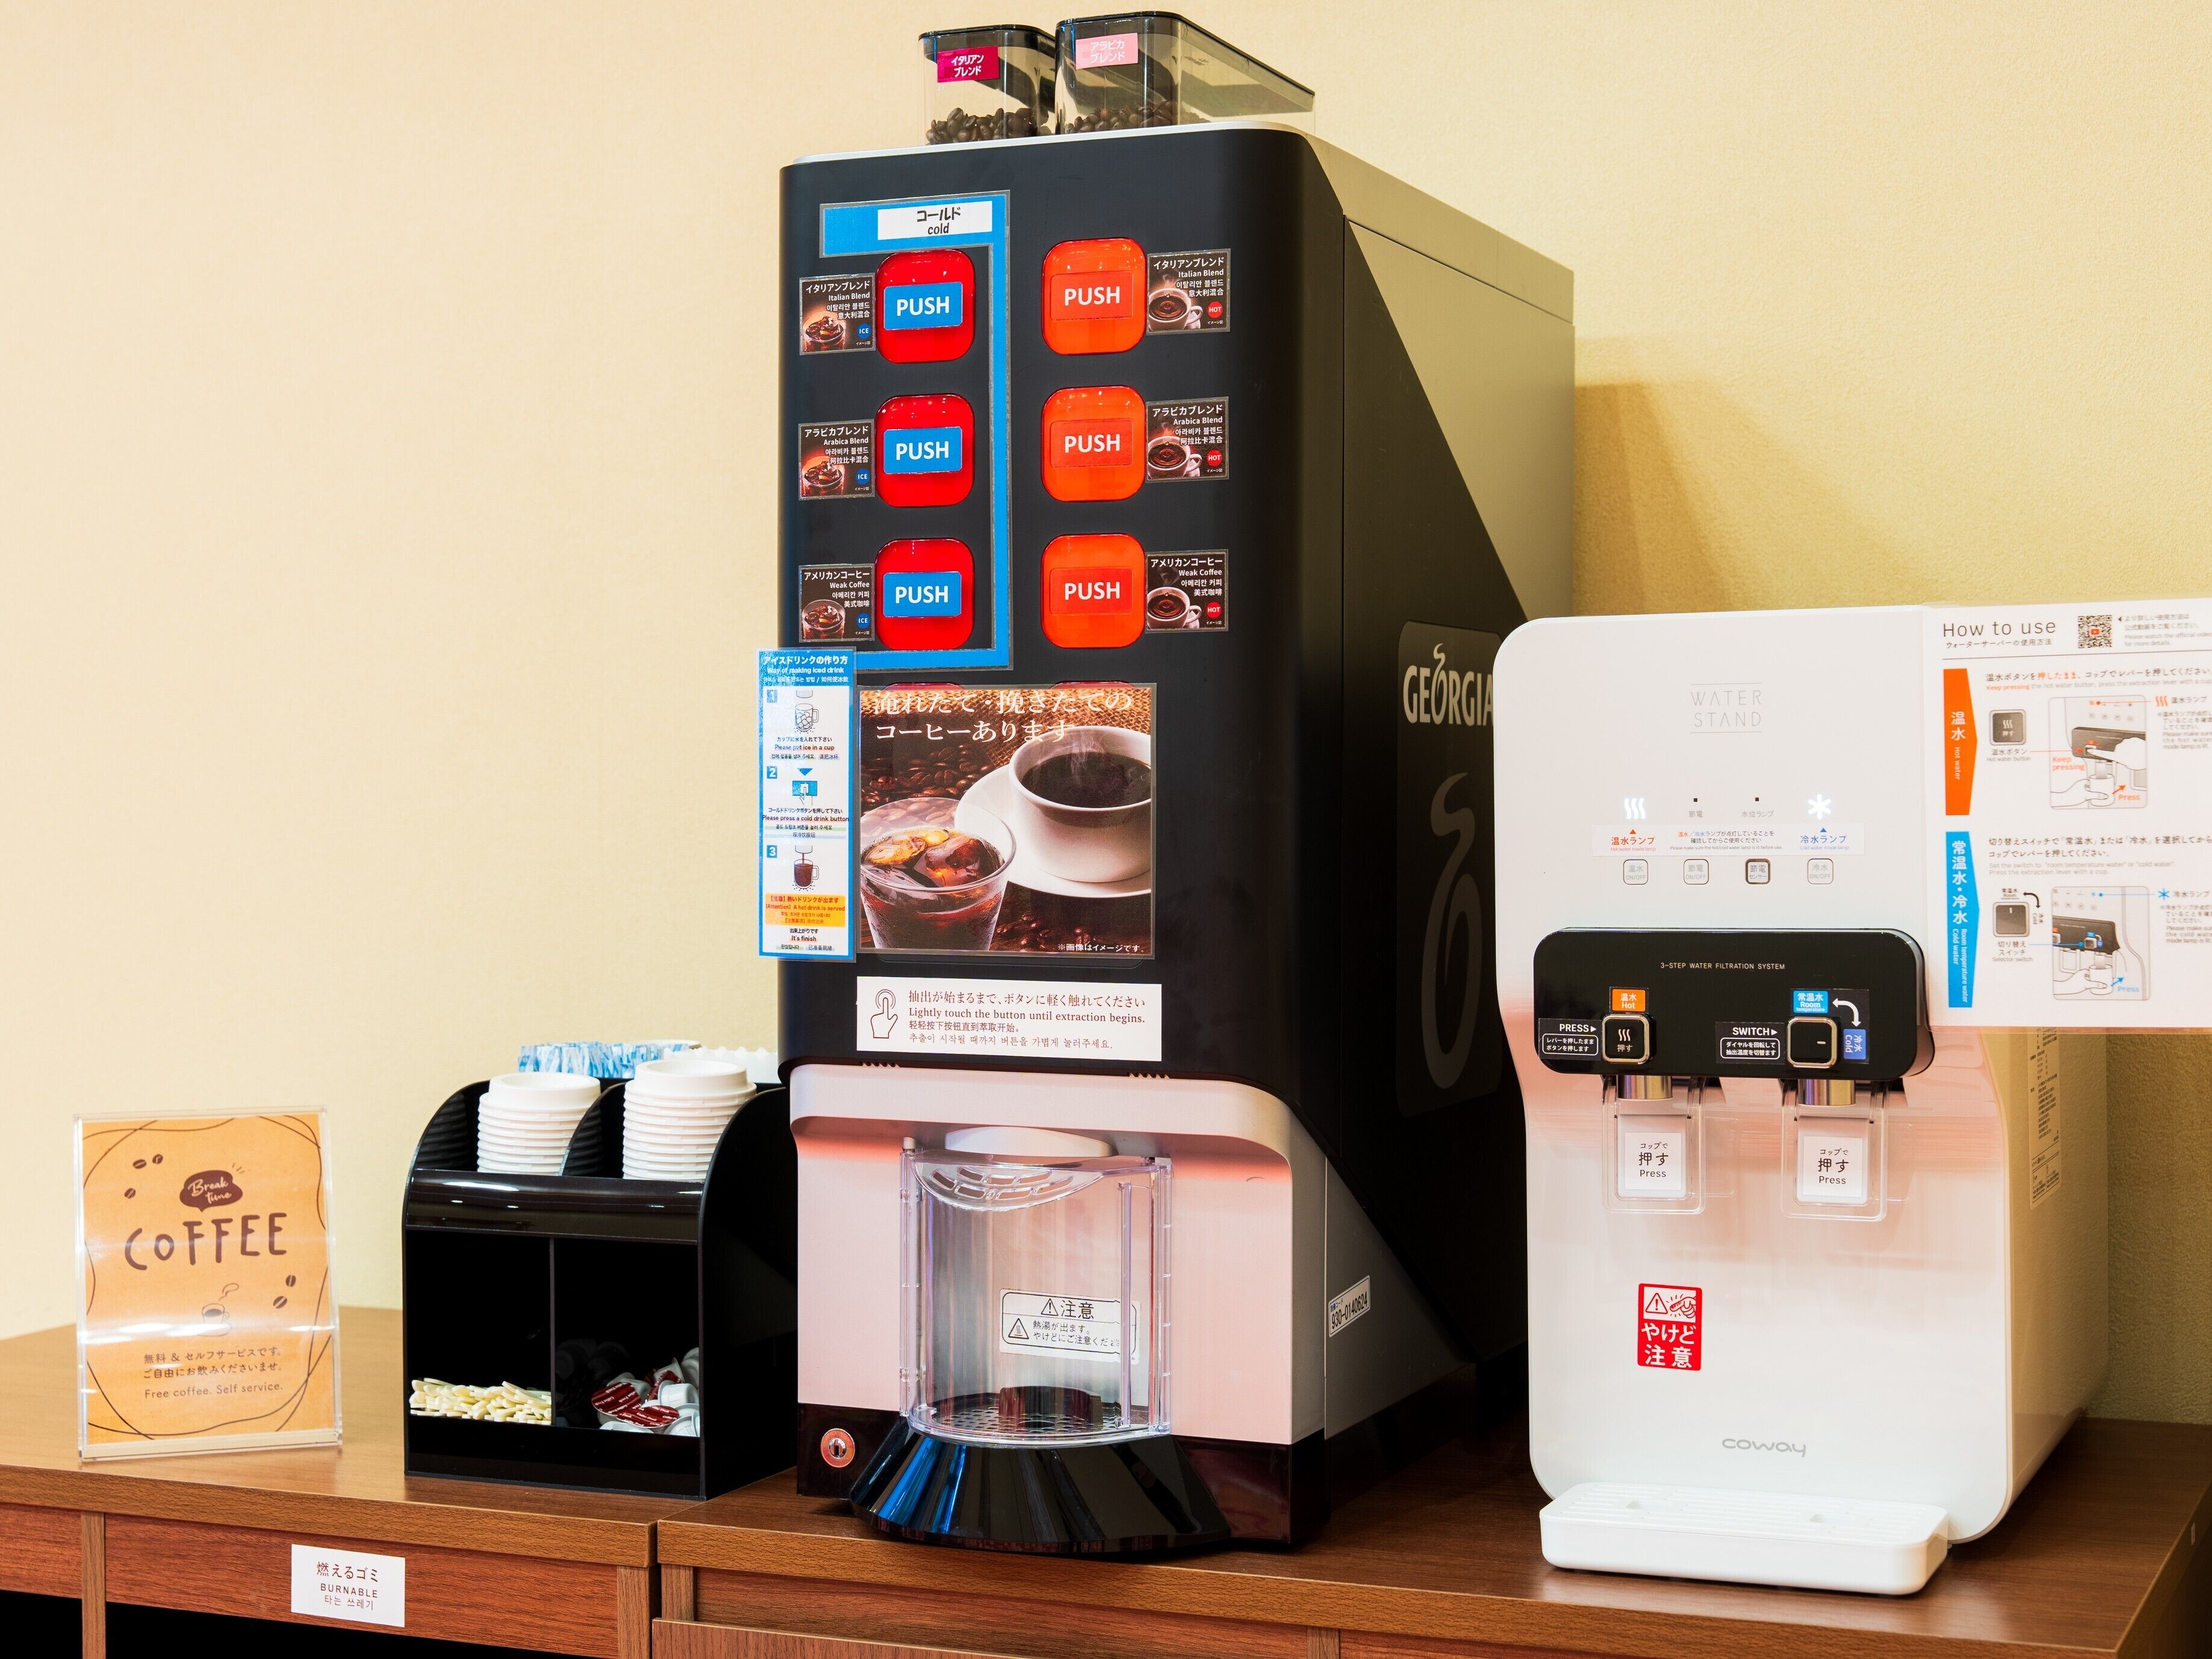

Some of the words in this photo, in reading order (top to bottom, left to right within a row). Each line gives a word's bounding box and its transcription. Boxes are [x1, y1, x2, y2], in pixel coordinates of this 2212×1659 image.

[1091, 40, 1125, 53] アラビカ
[951, 54, 984, 67] イタリアン
[1090, 51, 1126, 63] ブレンド
[953, 64, 982, 77] ブレンド
[916, 207, 961, 222] コールド
[928, 222, 949, 235] cold
[1153, 257, 1224, 270] イタリアンブレンド
[806, 281, 870, 294] イタリアンブレンド
[1188, 288, 1223, 297] 意大利混合
[1065, 286, 1120, 306] PUSH
[897, 296, 949, 316] PUSH
[838, 311, 870, 320] 意大利混合
[1153, 405, 1222, 417] アラビカブレンド
[805, 426, 868, 438] アラビカブレンド
[1203, 427, 1222, 435] 블렌드
[1065, 434, 1120, 453] PUSH
[1181, 436, 1222, 445] 阿拉比卡混合
[896, 441, 949, 460] PUSH
[831, 456, 869, 465] 阿拉比卡混合
[1151, 557, 1222, 568] アメリカンコーヒー
[804, 571, 870, 581] アメリカンコーヒー
[896, 586, 949, 603] PUSH
[1065, 581, 1120, 600] PUSH
[1943, 622, 1984, 637] How
[1994, 621, 2012, 635] to
[2022, 620, 2057, 634] use
[1946, 638, 2052, 648] ウォーターサーバーの使用方法
[764, 656, 848, 665] アイスドリンクの作り方
[1403, 643, 1494, 727] GEORGIA
[1691, 690, 1762, 705] WATER
[1694, 712, 1762, 727] STAND
[1951, 712, 1966, 740] 温水
[876, 721, 1075, 743] コーヒーあります
[769, 768, 776, 777] 2
[1611, 837, 1655, 845] 温水ランプ
[1801, 835, 1847, 843] 冷水ランプ
[769, 847, 776, 856] 3
[1952, 840, 1968, 925] 常温水・冷水
[1058, 943, 1144, 953] ※画像はイメージです。
[908, 990, 1145, 1008] 抽出が始まるまで、ボタンに軽く触れてください
[909, 1008, 942, 1019] Lightly
[944, 1008, 971, 1019] touch
[975, 1009, 990, 1019] the
[994, 1009, 1026, 1020] button
[1029, 1011, 1052, 1020] until
[1056, 1011, 1106, 1022] extraction
[1109, 1012, 1145, 1024] begins.
[909, 1020, 1021, 1033] 轻轻按下按钮直到萃取开始。
[1560, 1024, 1589, 1032] PRESS
[909, 1034, 935, 1044] 추출이
[940, 1034, 965, 1045] 시작될
[970, 1035, 997, 1045] 때까지
[1001, 1036, 1027, 1047] 버튼을
[1032, 1037, 1059, 1047] 가볍게
[1064, 1038, 1112, 1049] 눌러주세요.
[1617, 1044, 1632, 1052] 押す
[1854, 1035, 1862, 1052] 冷水
[1640, 1142, 1668, 1150] コップで
[1820, 1148, 1848, 1156] コップで
[1639, 1152, 1668, 1167] 押す
[1818, 1157, 1849, 1173] 押す
[1640, 1169, 1666, 1179] Press
[1818, 1175, 1846, 1185] Press
[188, 1176, 228, 1197] Break
[205, 1191, 232, 1204] time
[1061, 1300, 1094, 1319] 注意
[1332, 1291, 1367, 1329] 930-0140624
[1033, 1321, 1089, 1335] 熱湯が出ます。
[1641, 1323, 1696, 1345] やけど
[144, 1353, 165, 1364] 無料
[172, 1353, 180, 1362] &
[185, 1347, 281, 1361] セルフサービスです。
[1644, 1344, 1693, 1368] 注意
[144, 1362, 282, 1378] ご自由にお飲みくださいませ。
[145, 1389, 169, 1398] Free
[173, 1387, 212, 1397] coffee.
[217, 1384, 238, 1394] Self
[242, 1382, 283, 1392] service.
[1722, 1438, 1806, 1458] coway
[317, 1561, 378, 1582] 燃えるゴミ
[321, 1583, 377, 1598] BURNABLE
[325, 1595, 341, 1606] 타는
[347, 1598, 373, 1610] 쓰레기
